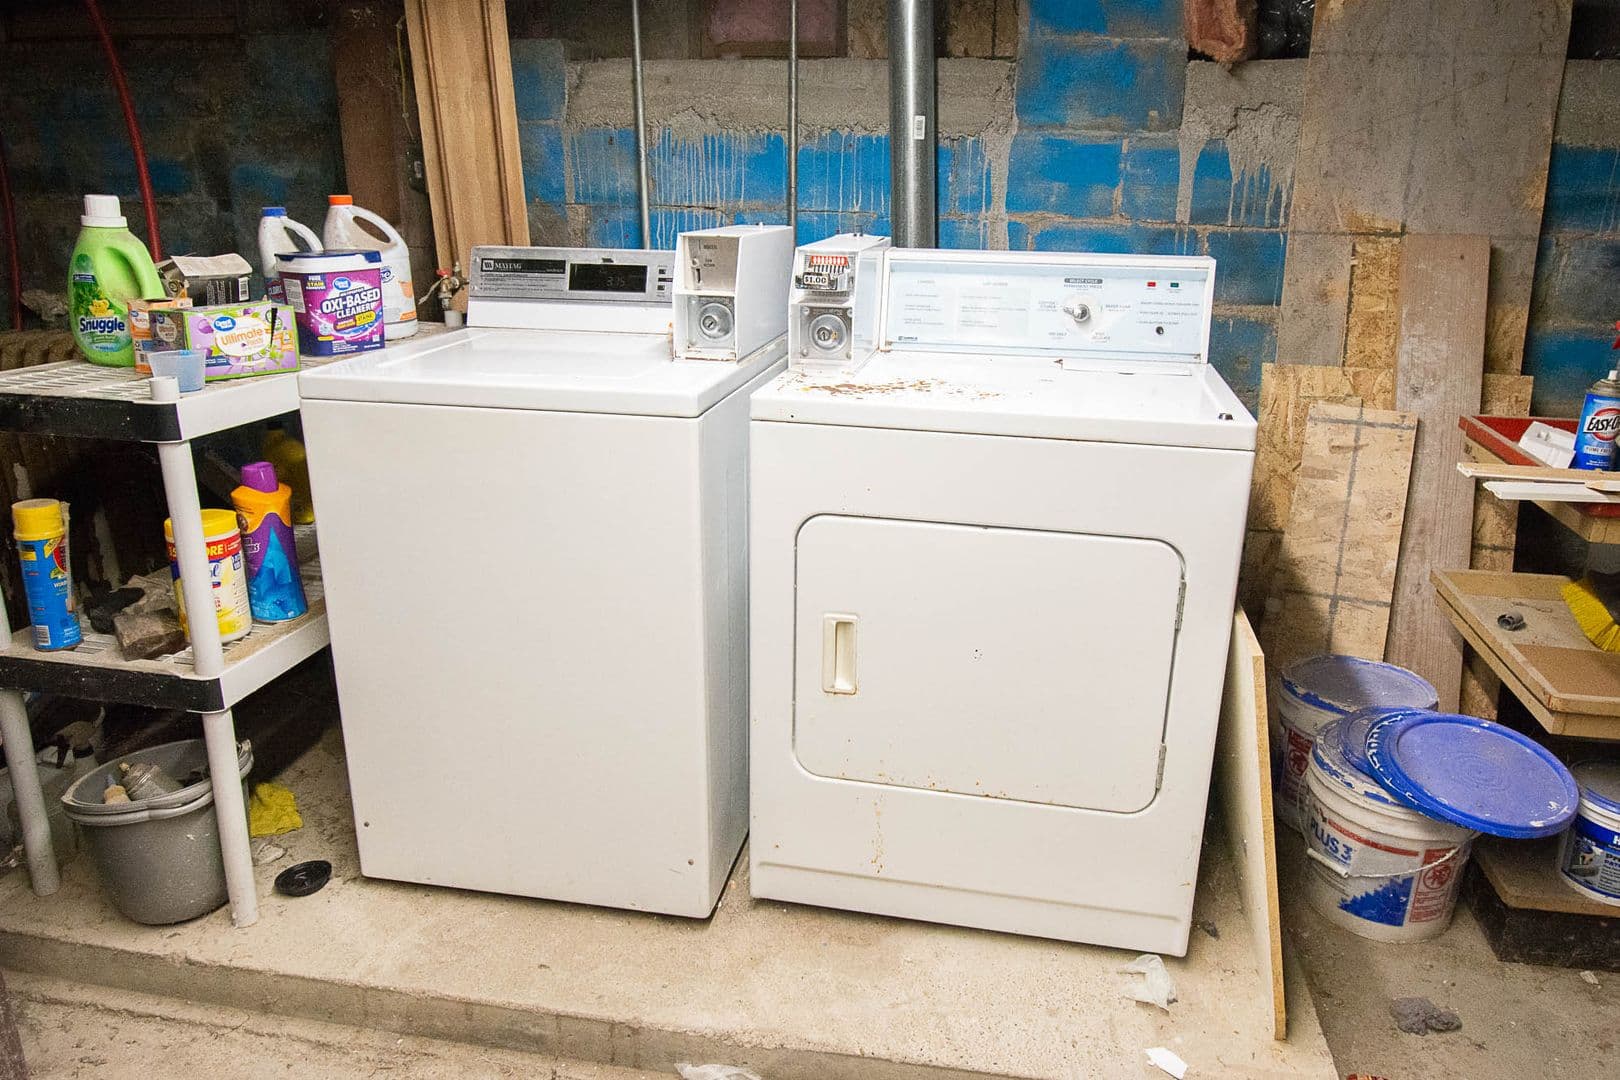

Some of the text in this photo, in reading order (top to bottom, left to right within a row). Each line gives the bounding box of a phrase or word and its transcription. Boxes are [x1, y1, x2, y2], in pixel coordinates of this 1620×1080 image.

[321, 288, 381, 314] OXI-BASED
[79, 316, 126, 333] Snuggle
[220, 327, 263, 346] Ultimate
[1311, 816, 1340, 854] PLUS
